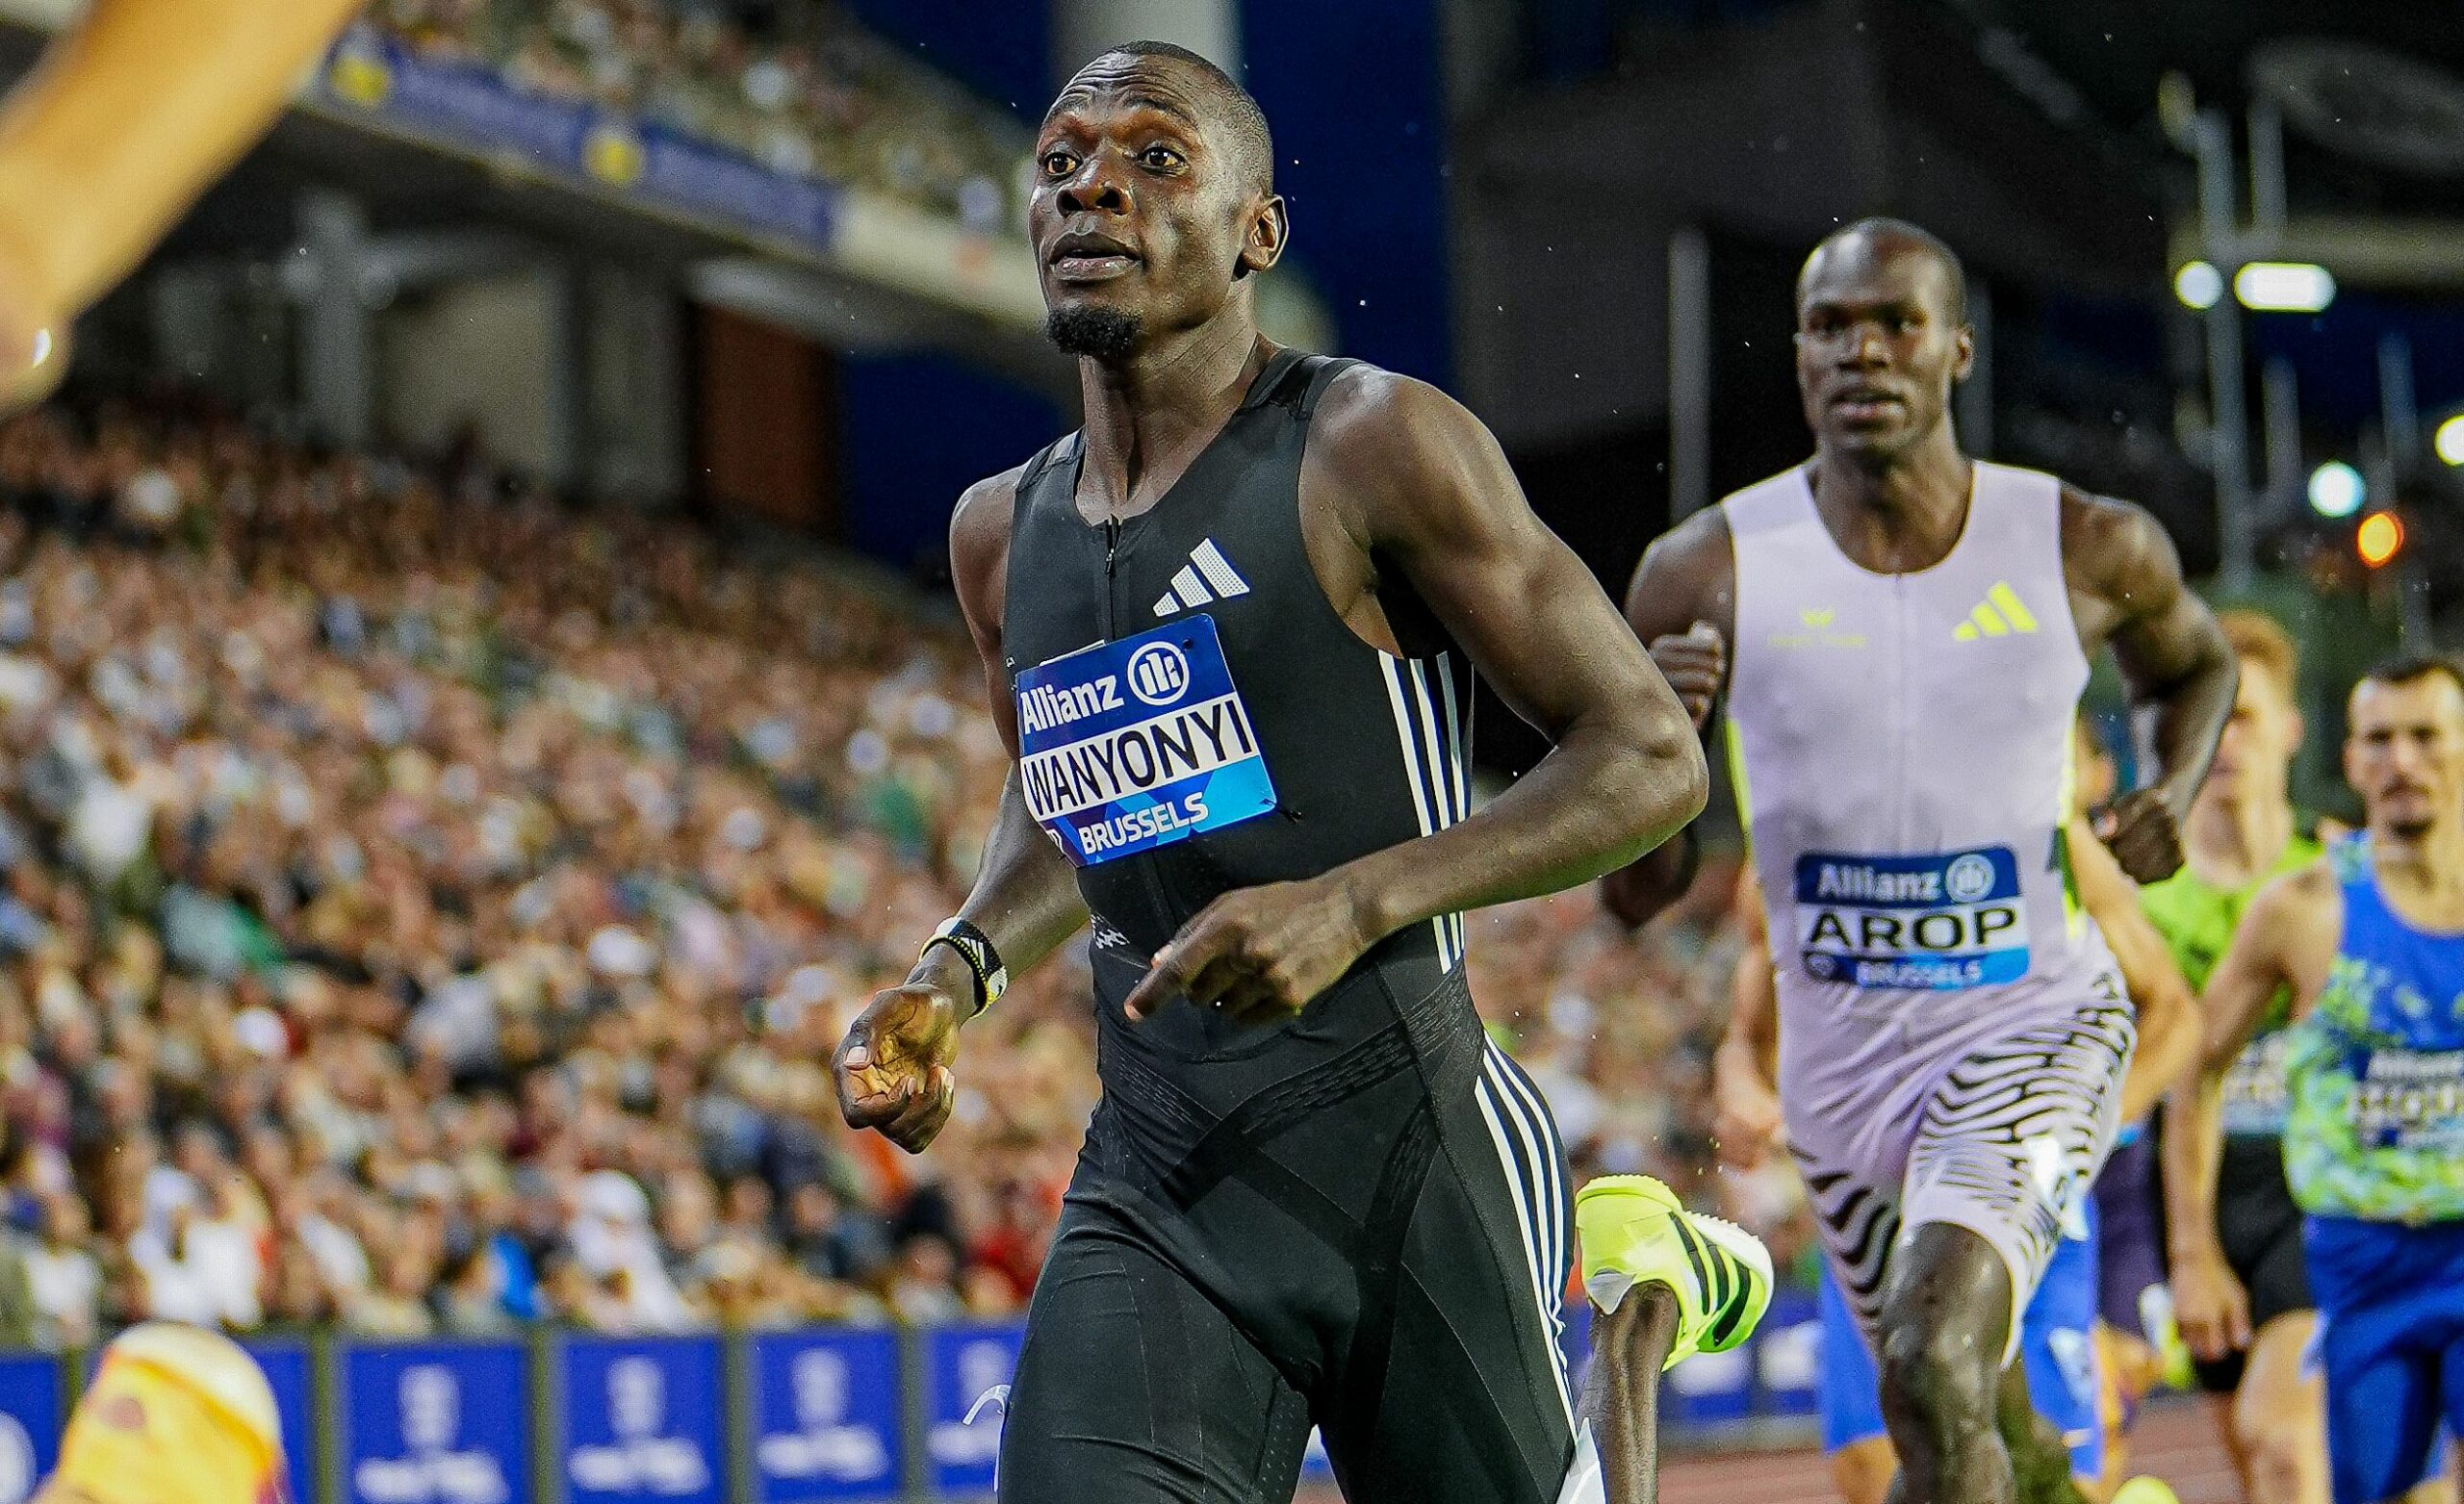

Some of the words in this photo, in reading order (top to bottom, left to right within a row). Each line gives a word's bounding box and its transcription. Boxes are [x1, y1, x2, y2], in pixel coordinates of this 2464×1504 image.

[1020, 675, 1124, 735] Allianz
[1023, 700, 1252, 817] WANYONYI
[1078, 791, 1209, 855] BRUSSELS
[1817, 862, 1942, 903] Allianz
[1810, 907, 2017, 951] AROP
